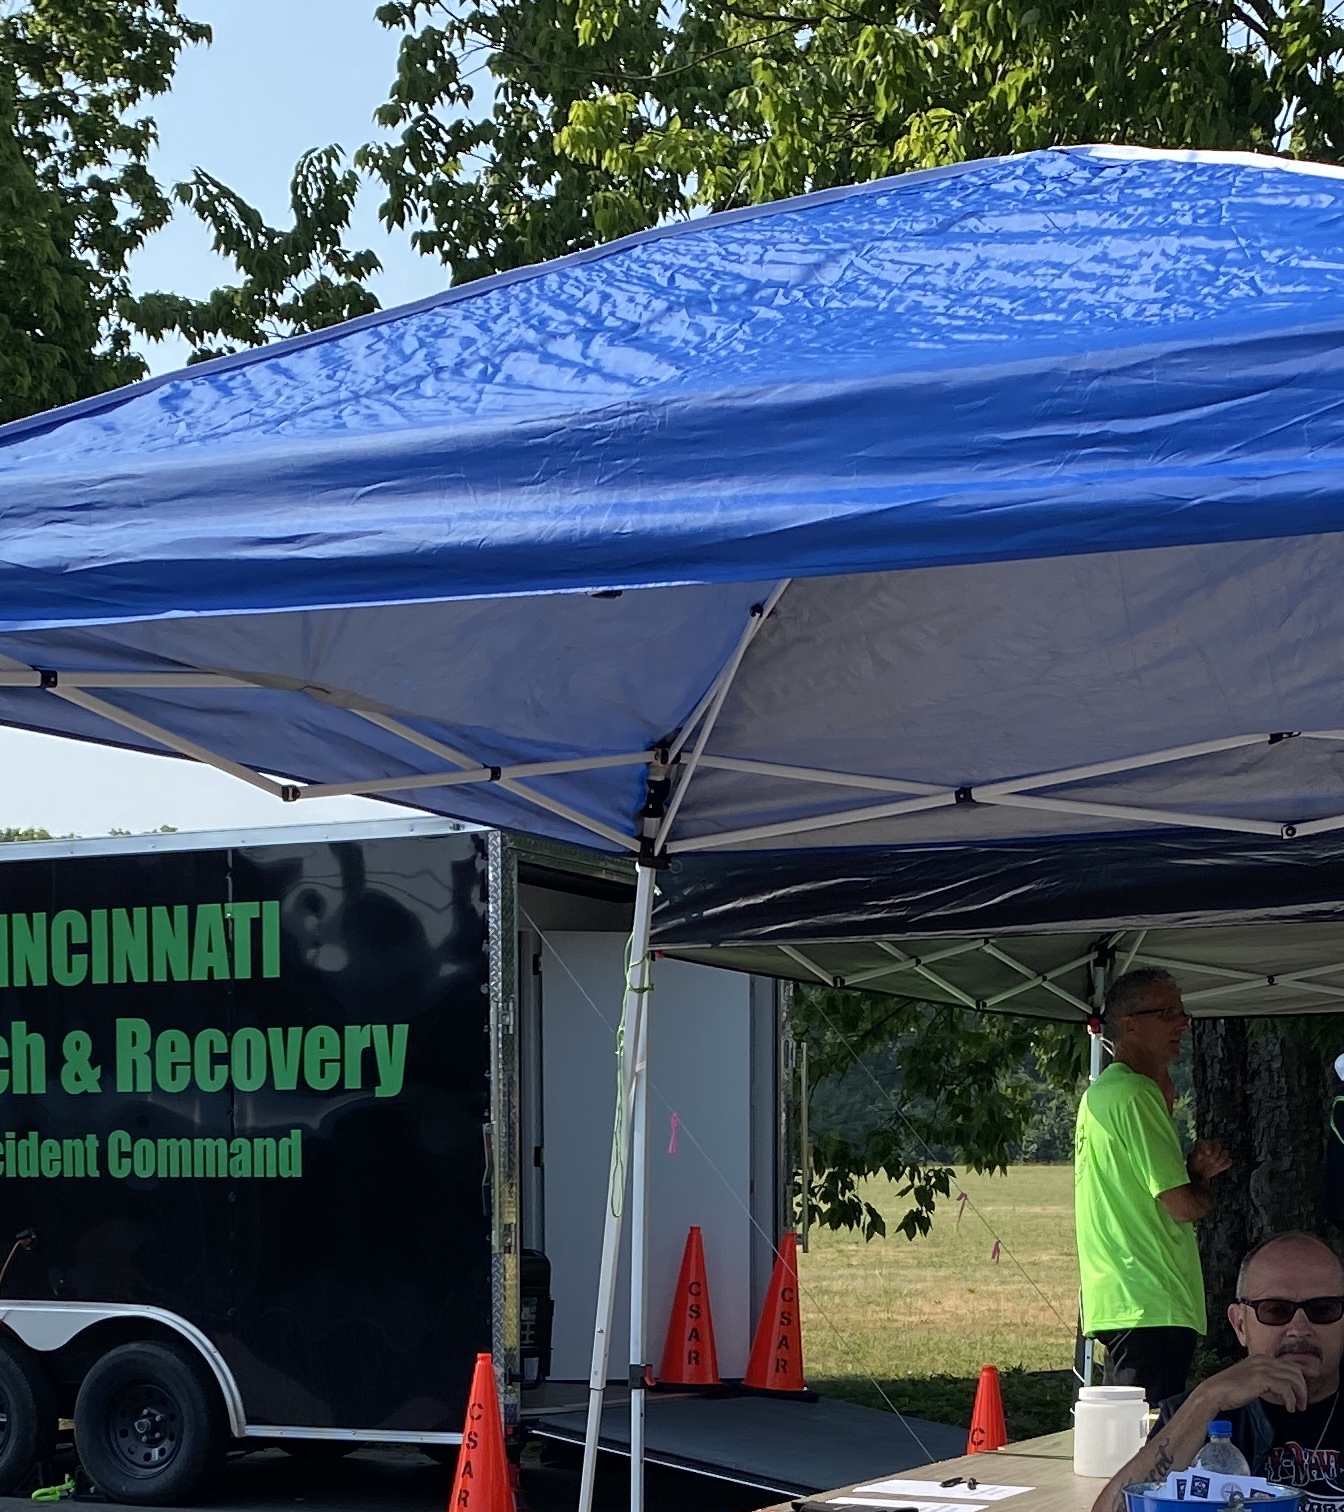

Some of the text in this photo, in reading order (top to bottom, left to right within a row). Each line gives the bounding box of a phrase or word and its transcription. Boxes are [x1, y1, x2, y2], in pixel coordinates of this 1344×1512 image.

[60, 1030, 102, 1094] &
[116, 1017, 410, 1098] Recovery
[107, 1128, 303, 1179] Command
[687, 1281, 702, 1366] CSAR
[774, 1287, 795, 1374] CSAR
[457, 1403, 483, 1508] CSAR
